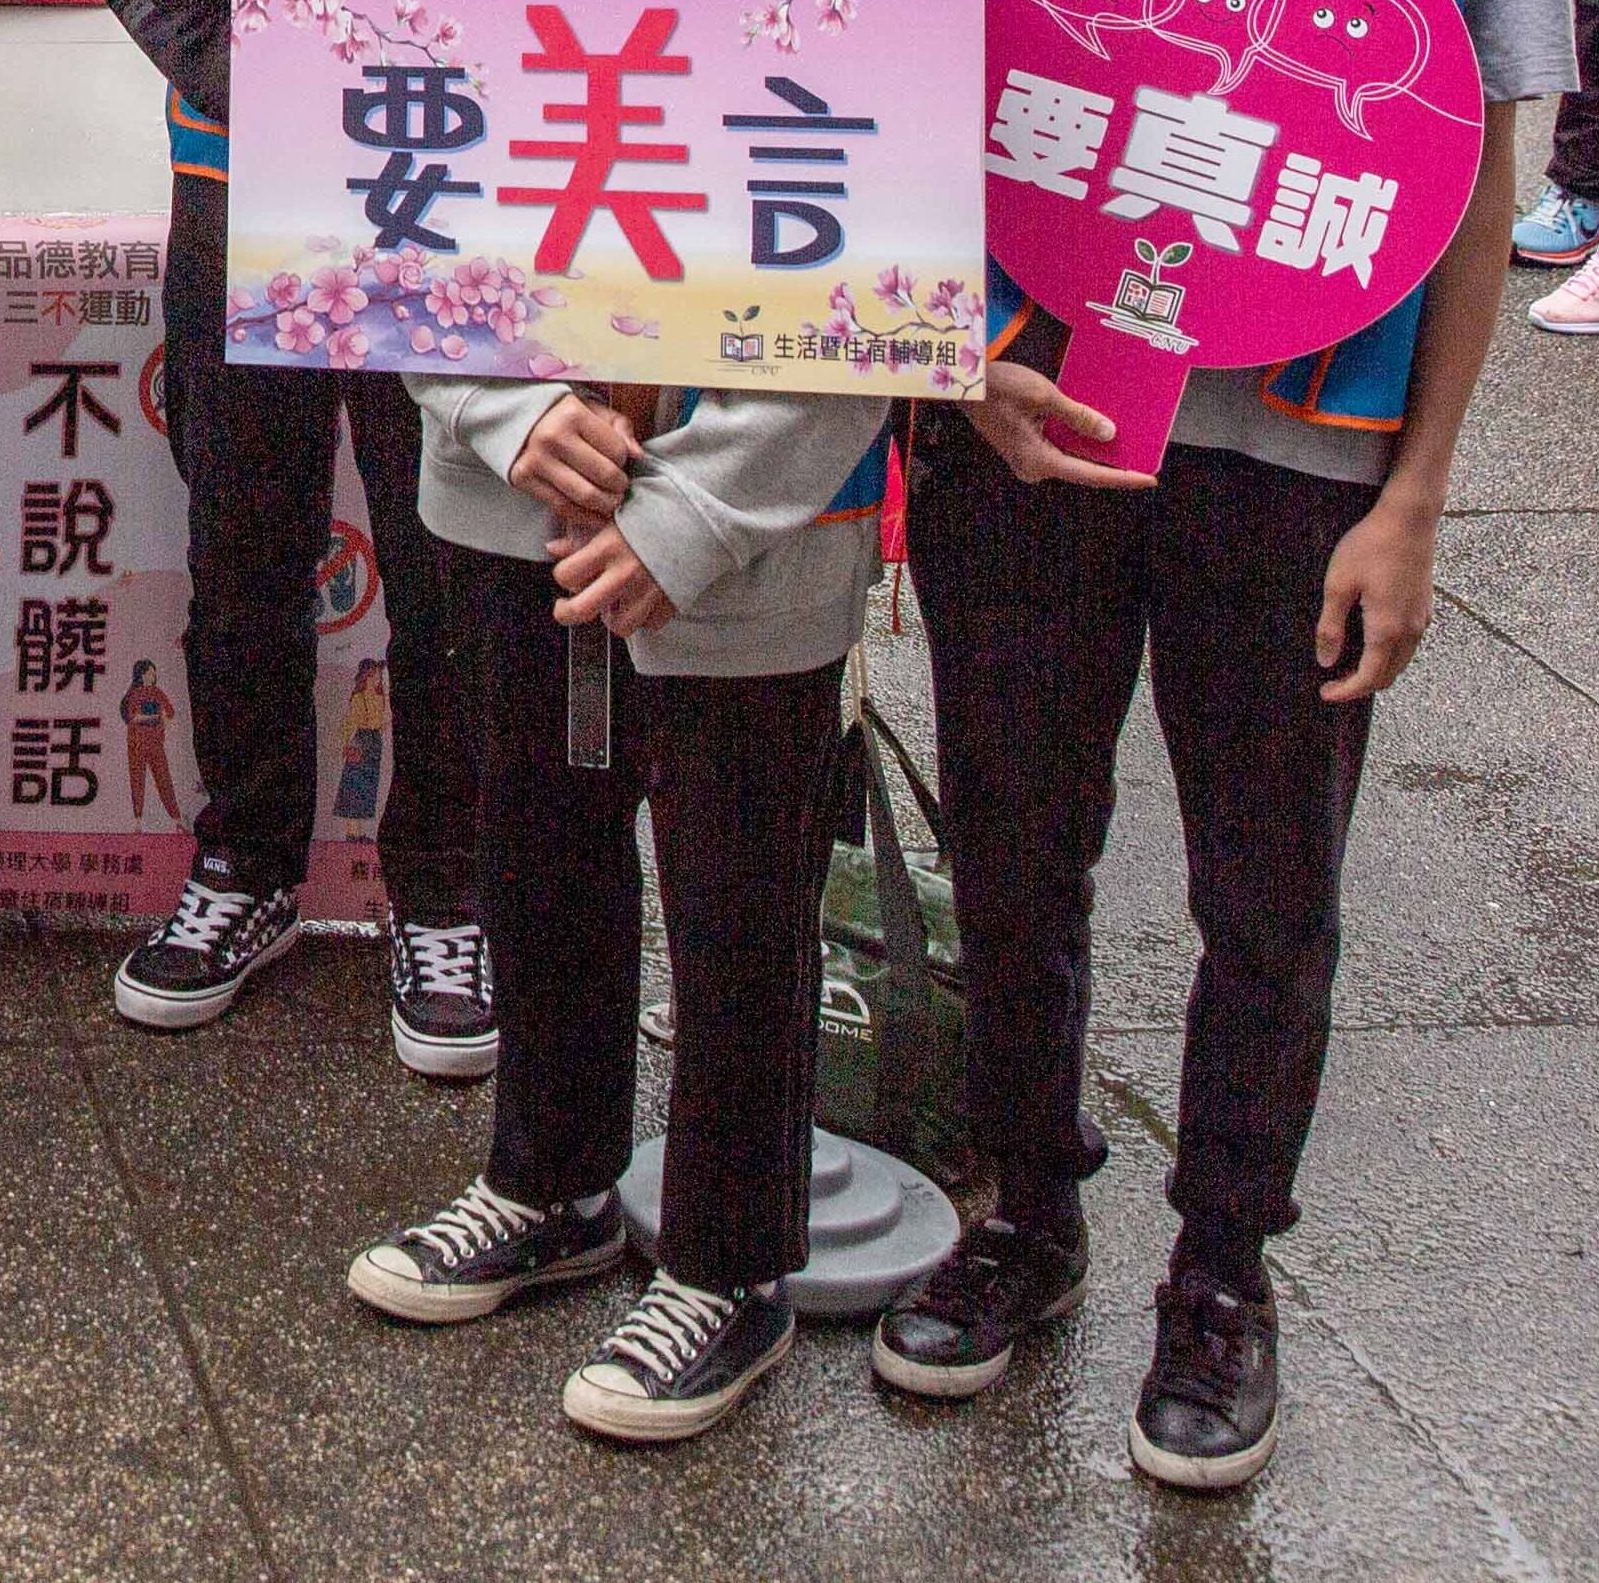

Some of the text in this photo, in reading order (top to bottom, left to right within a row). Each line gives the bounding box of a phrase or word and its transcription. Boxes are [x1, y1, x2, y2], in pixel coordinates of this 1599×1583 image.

[343, 4, 879, 283] 要美言
[985, 69, 1399, 291] 要真誠
[3, 289, 151, 327] 三不運動
[772, 331, 959, 368] 生活暨住宿輔導組
[10, 358, 124, 808] 不說髒話
